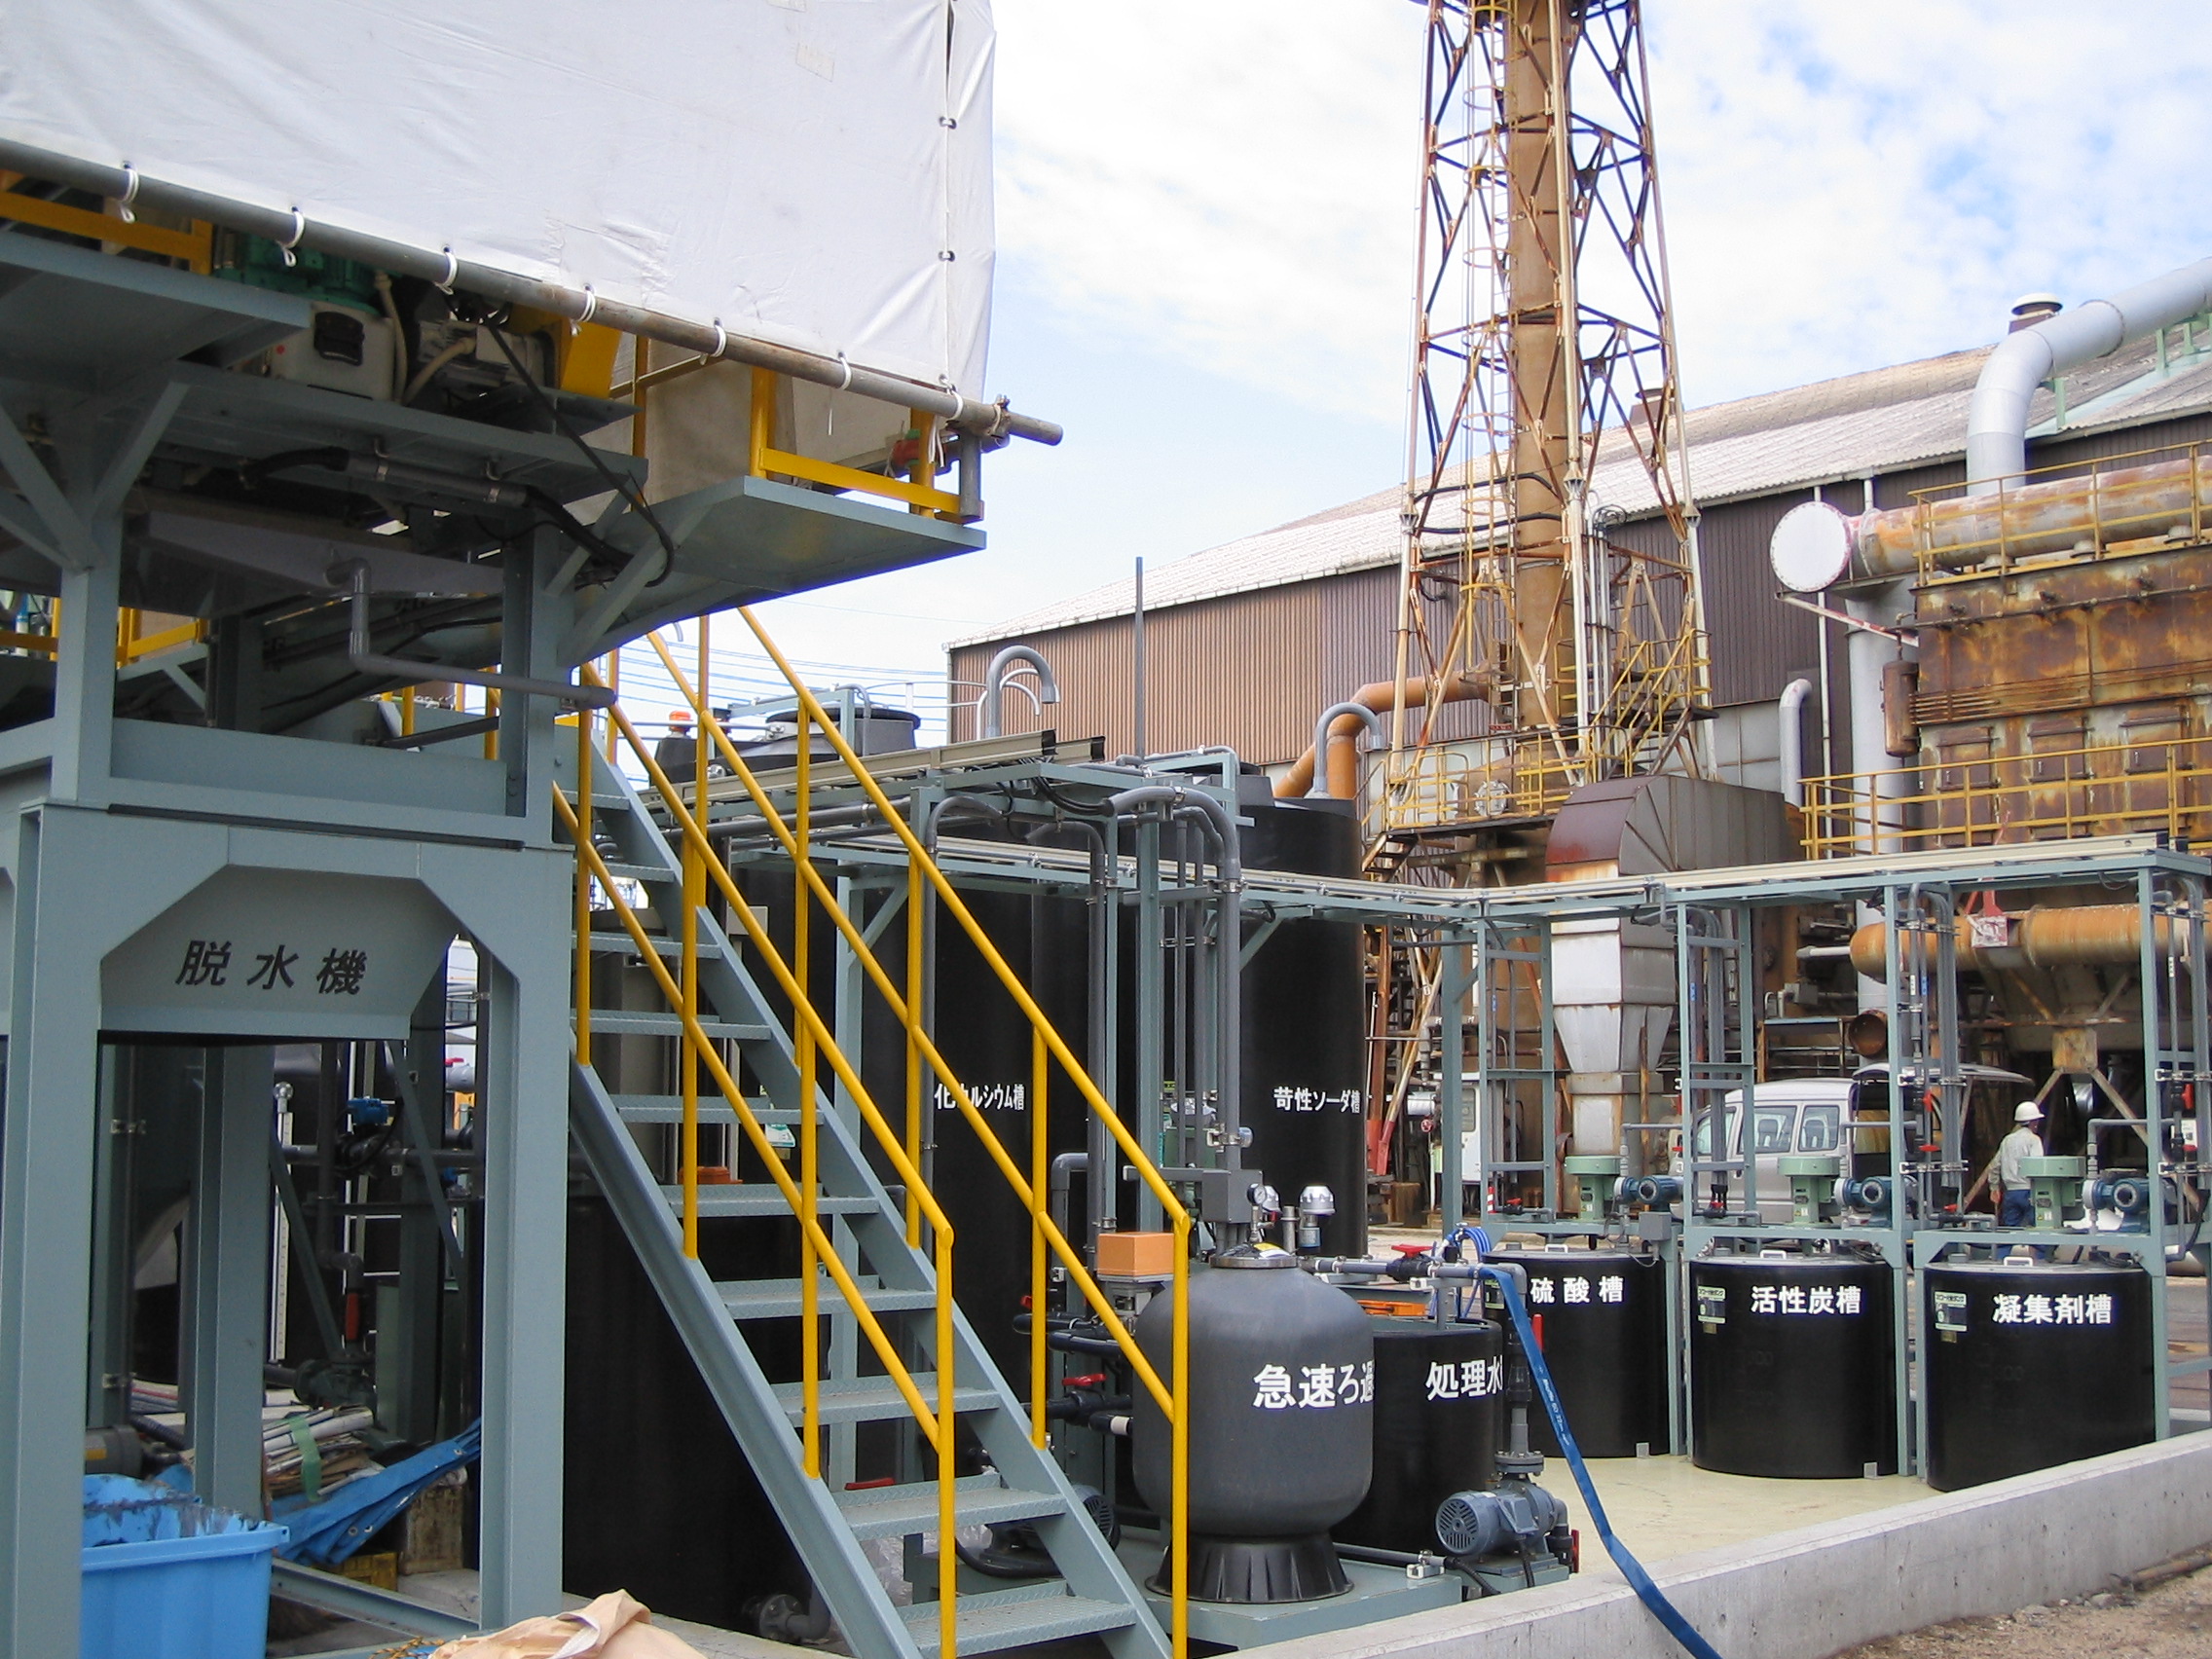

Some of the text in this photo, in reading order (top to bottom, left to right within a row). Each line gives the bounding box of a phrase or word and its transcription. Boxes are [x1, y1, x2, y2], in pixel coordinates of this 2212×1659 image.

[175, 940, 368, 995] 脱水機
[1273, 1086, 1361, 1114] 苛性ソーダ槽
[1530, 1275, 1624, 1304] 硫酸槽
[1751, 1285, 1862, 1315] 活性炭槽
[1992, 1293, 2113, 1326] 凝集剤槽
[1425, 1354, 1503, 1401] 処理水
